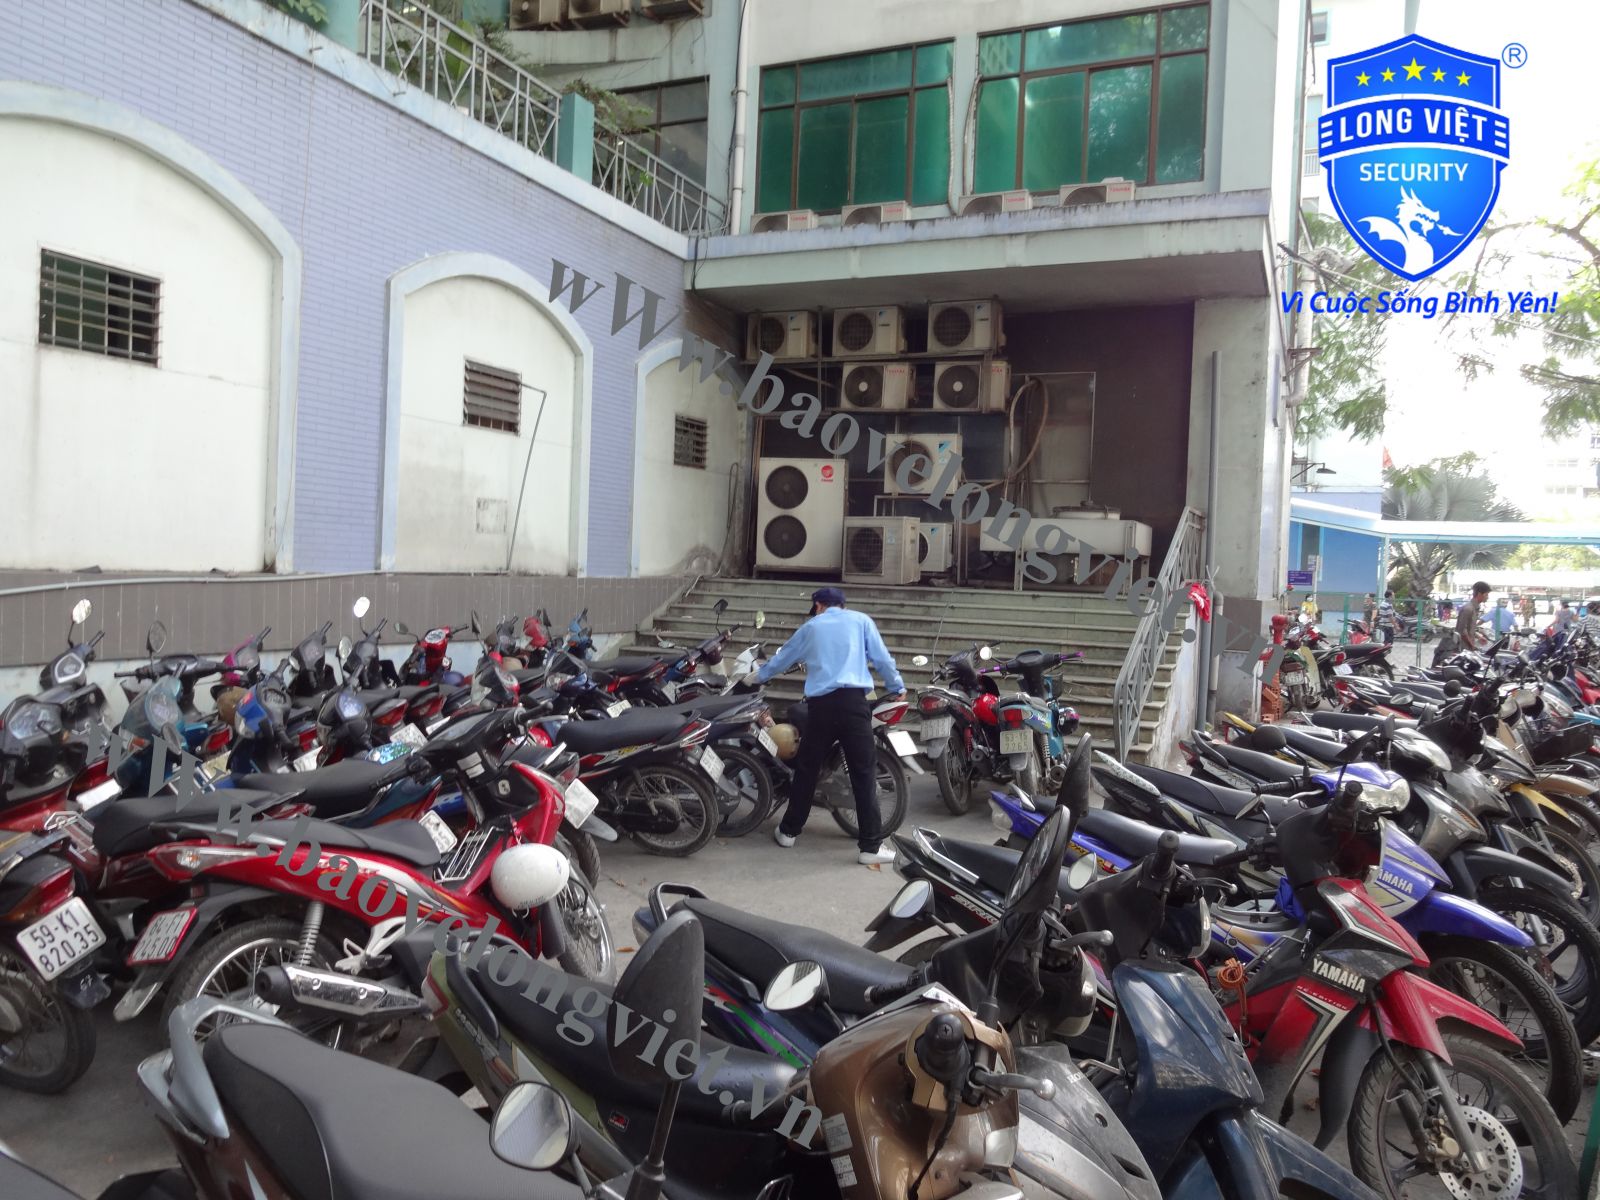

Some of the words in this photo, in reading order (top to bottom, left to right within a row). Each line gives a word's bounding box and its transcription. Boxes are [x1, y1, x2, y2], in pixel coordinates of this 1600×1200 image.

[29, 908, 80, 950] 59-K1
[38, 923, 100, 973] 820.35
[1312, 957, 1366, 993] YAMAHA
